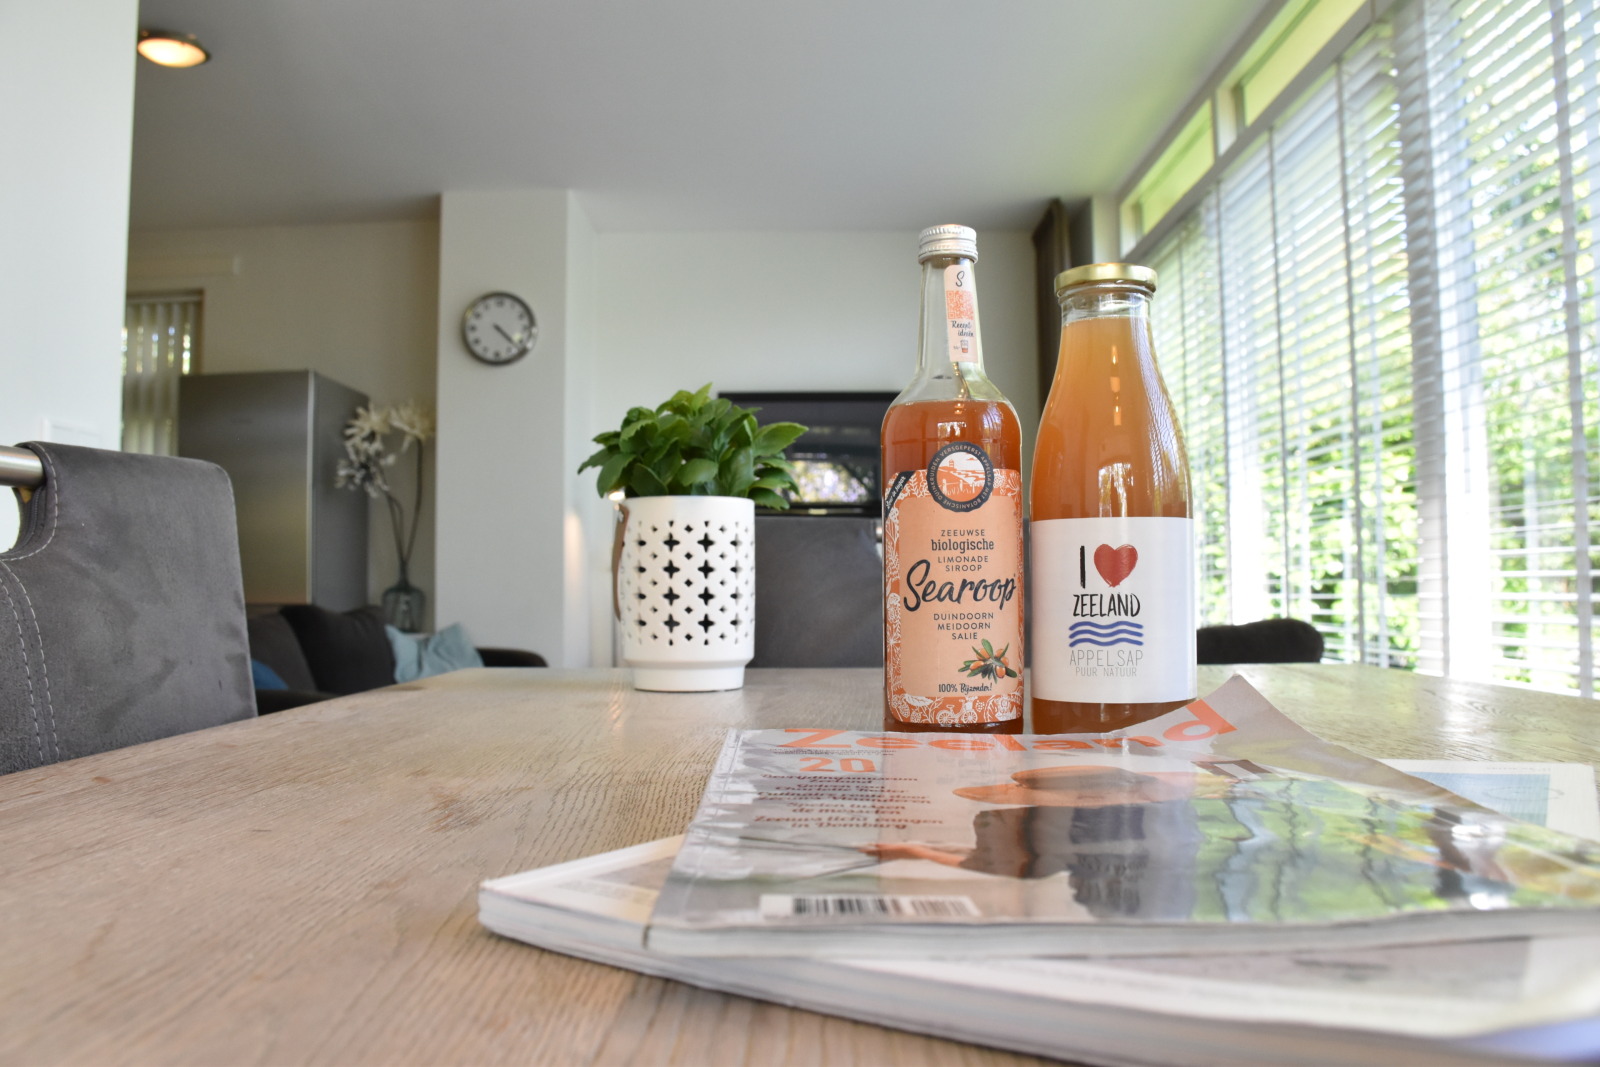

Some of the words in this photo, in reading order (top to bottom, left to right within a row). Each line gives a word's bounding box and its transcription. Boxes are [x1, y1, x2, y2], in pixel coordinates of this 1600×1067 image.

[939, 444, 982, 458] VERSGEPERST
[980, 454, 993, 486] APPELSAP
[929, 457, 943, 501] DUINKRUIDEN
[942, 497, 983, 509] BOTANISCHE
[941, 529, 985, 537] ZEEUWSE
[931, 538, 994, 554] biologische
[937, 555, 989, 563] LIMONADE
[945, 564, 983, 572] SIROOP
[1079, 545, 1087, 589] I
[903, 559, 1016, 611] Searoop
[1072, 592, 1141, 618] ZEELAND
[933, 612, 994, 621] DUINDOORN
[937, 622, 991, 631] MEIDOORN
[951, 632, 978, 640] SALIE
[1069, 649, 1144, 667] APPELSAP
[1075, 667, 1098, 677] PUUR
[1103, 667, 1137, 677] NATUUR
[938, 684, 958, 693] 100%
[777, 699, 1238, 751] Zeeland
[799, 757, 876, 773] 20
